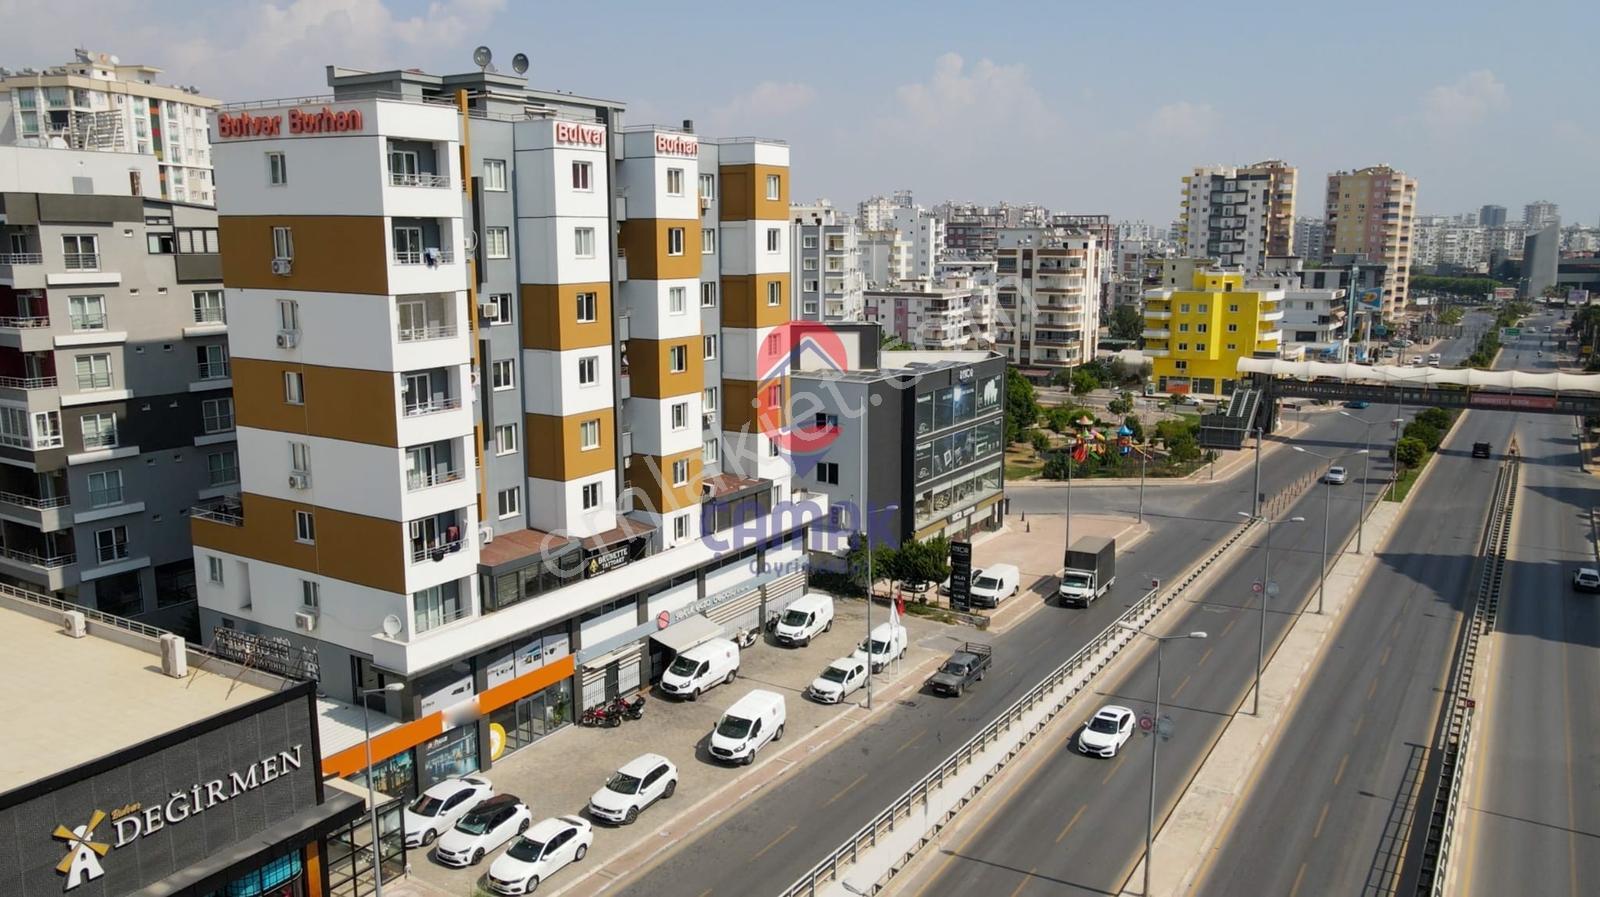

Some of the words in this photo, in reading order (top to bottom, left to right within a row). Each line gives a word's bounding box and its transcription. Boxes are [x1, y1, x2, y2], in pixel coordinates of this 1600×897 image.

[217, 112, 282, 138] Bulvar
[288, 105, 363, 134] Burhan
[656, 134, 699, 156] Burhan
[112, 744, 303, 849] DEĞİRMEN
